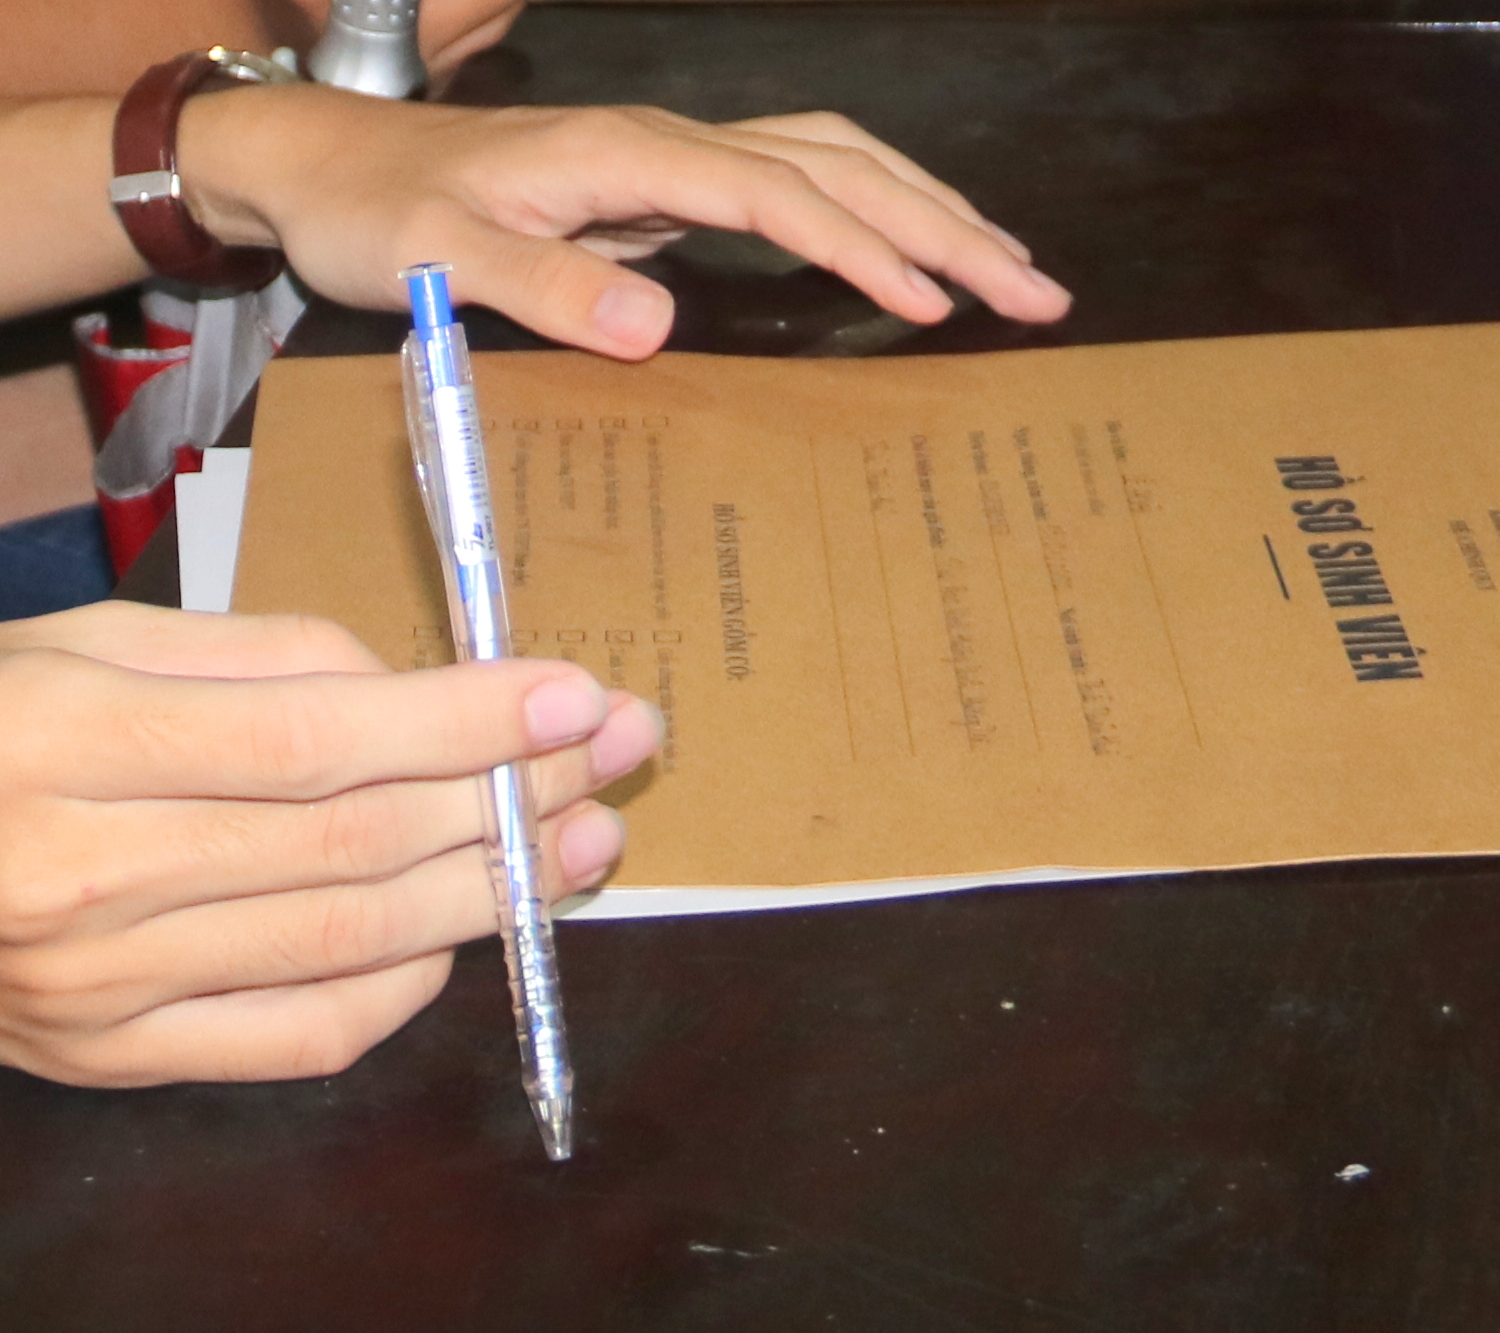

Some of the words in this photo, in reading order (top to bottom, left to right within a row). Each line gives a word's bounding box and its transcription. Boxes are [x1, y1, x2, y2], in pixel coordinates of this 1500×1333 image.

[1273, 456, 1366, 491] HỒ
[1290, 498, 1374, 534] SƠ
[1307, 541, 1394, 608] SINH
[1335, 614, 1427, 683] VIÊN
